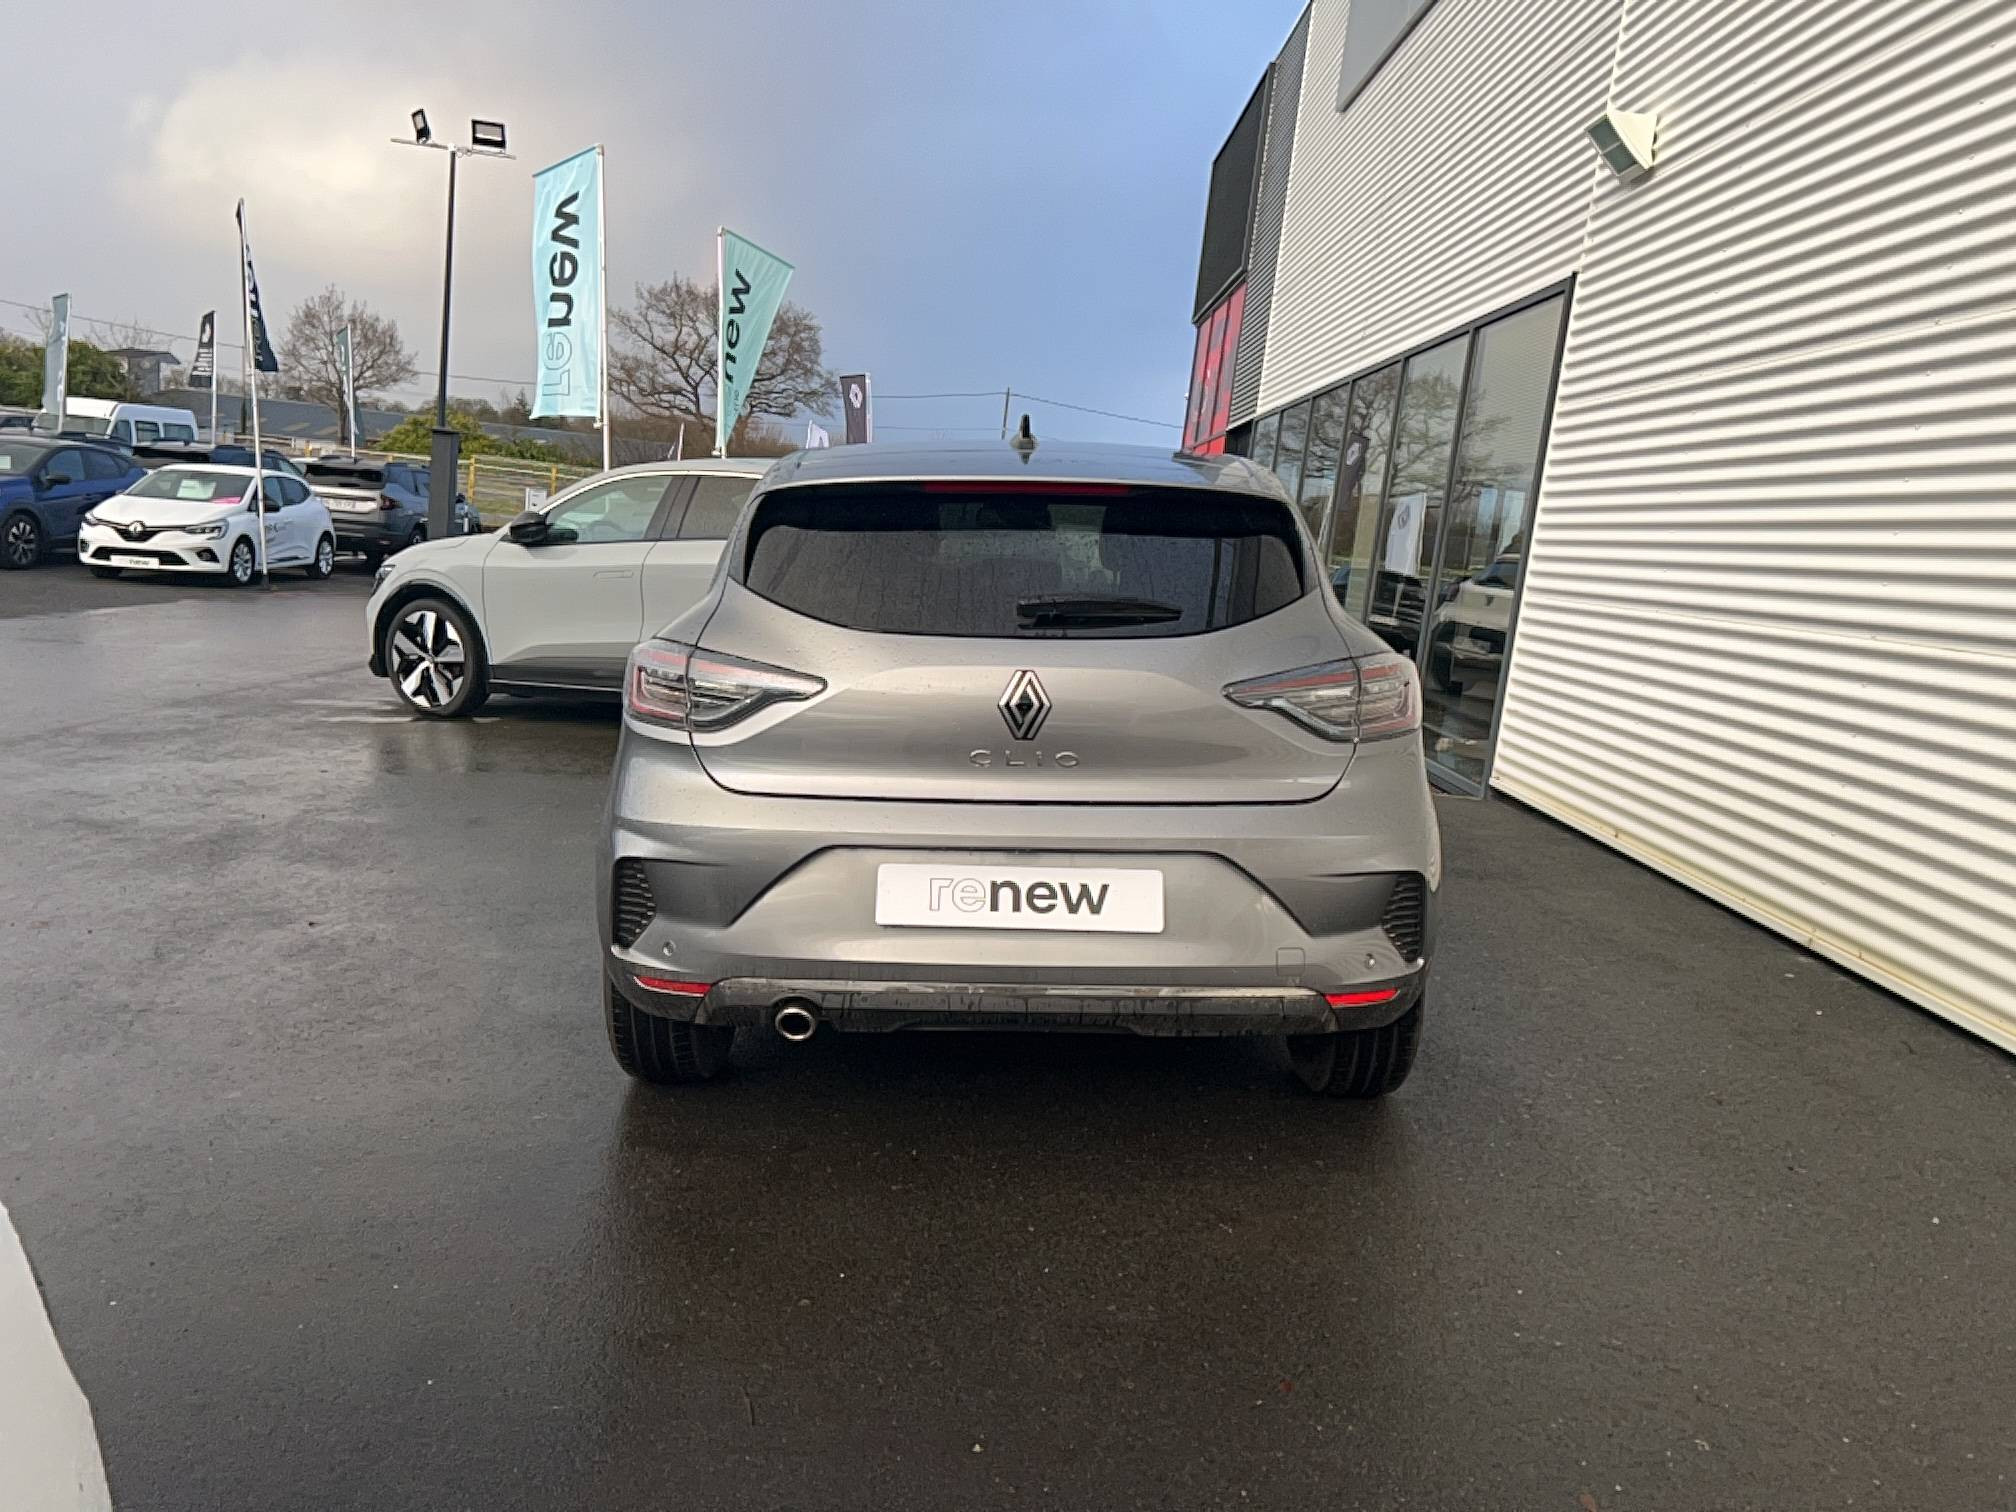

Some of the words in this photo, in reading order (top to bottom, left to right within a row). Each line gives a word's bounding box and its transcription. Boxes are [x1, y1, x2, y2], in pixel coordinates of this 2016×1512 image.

[725, 268, 751, 384] new
[969, 749, 1080, 768] CLIO
[928, 877, 1110, 915] renew
